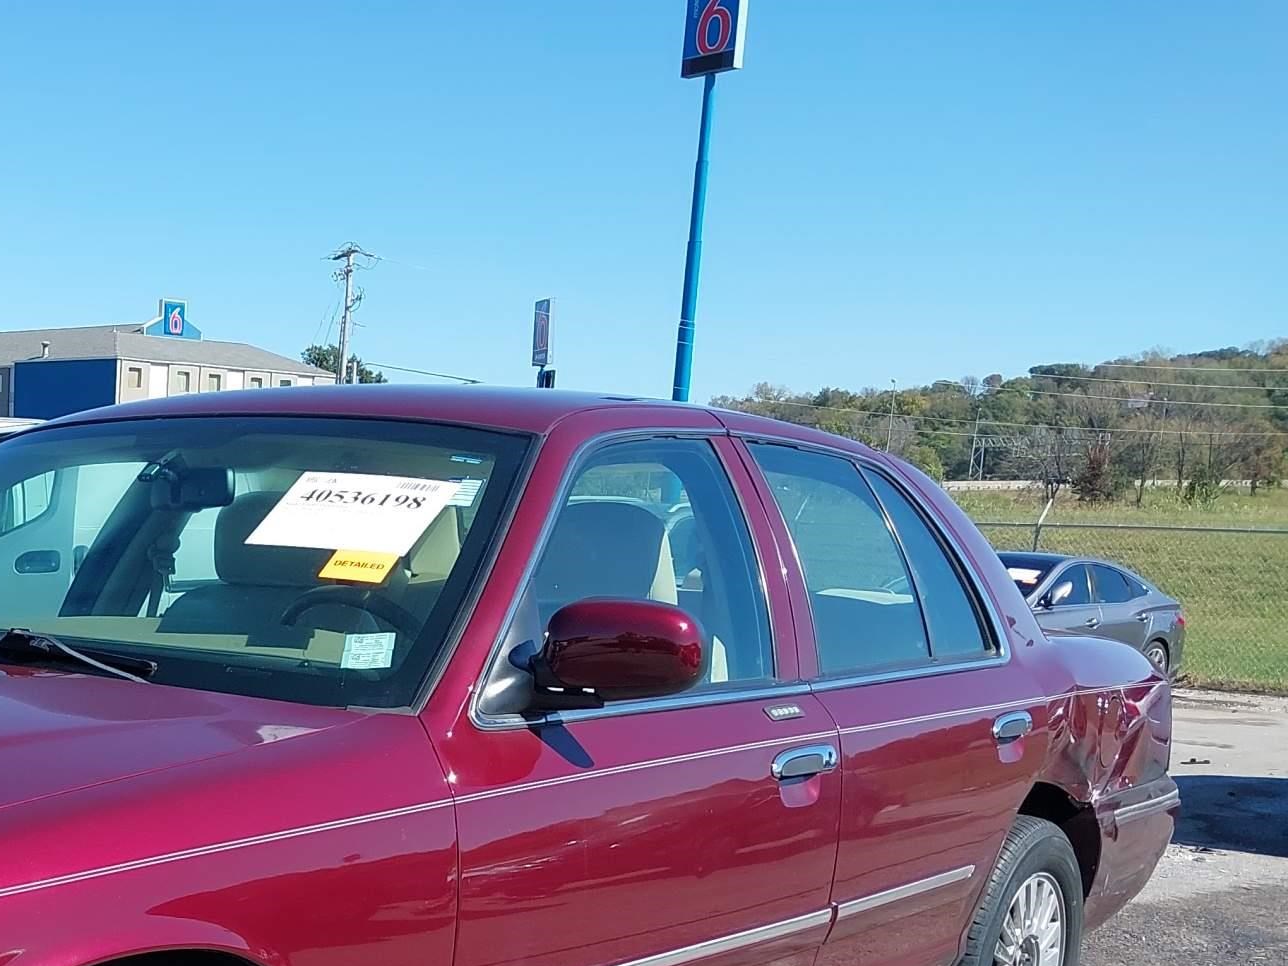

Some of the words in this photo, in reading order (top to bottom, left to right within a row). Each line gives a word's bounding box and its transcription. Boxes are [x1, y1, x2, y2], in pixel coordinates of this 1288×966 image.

[696, 0, 732, 55] 6
[169, 307, 183, 335] 6
[300, 488, 427, 510] 40536198
[333, 560, 385, 570] DETAILED
